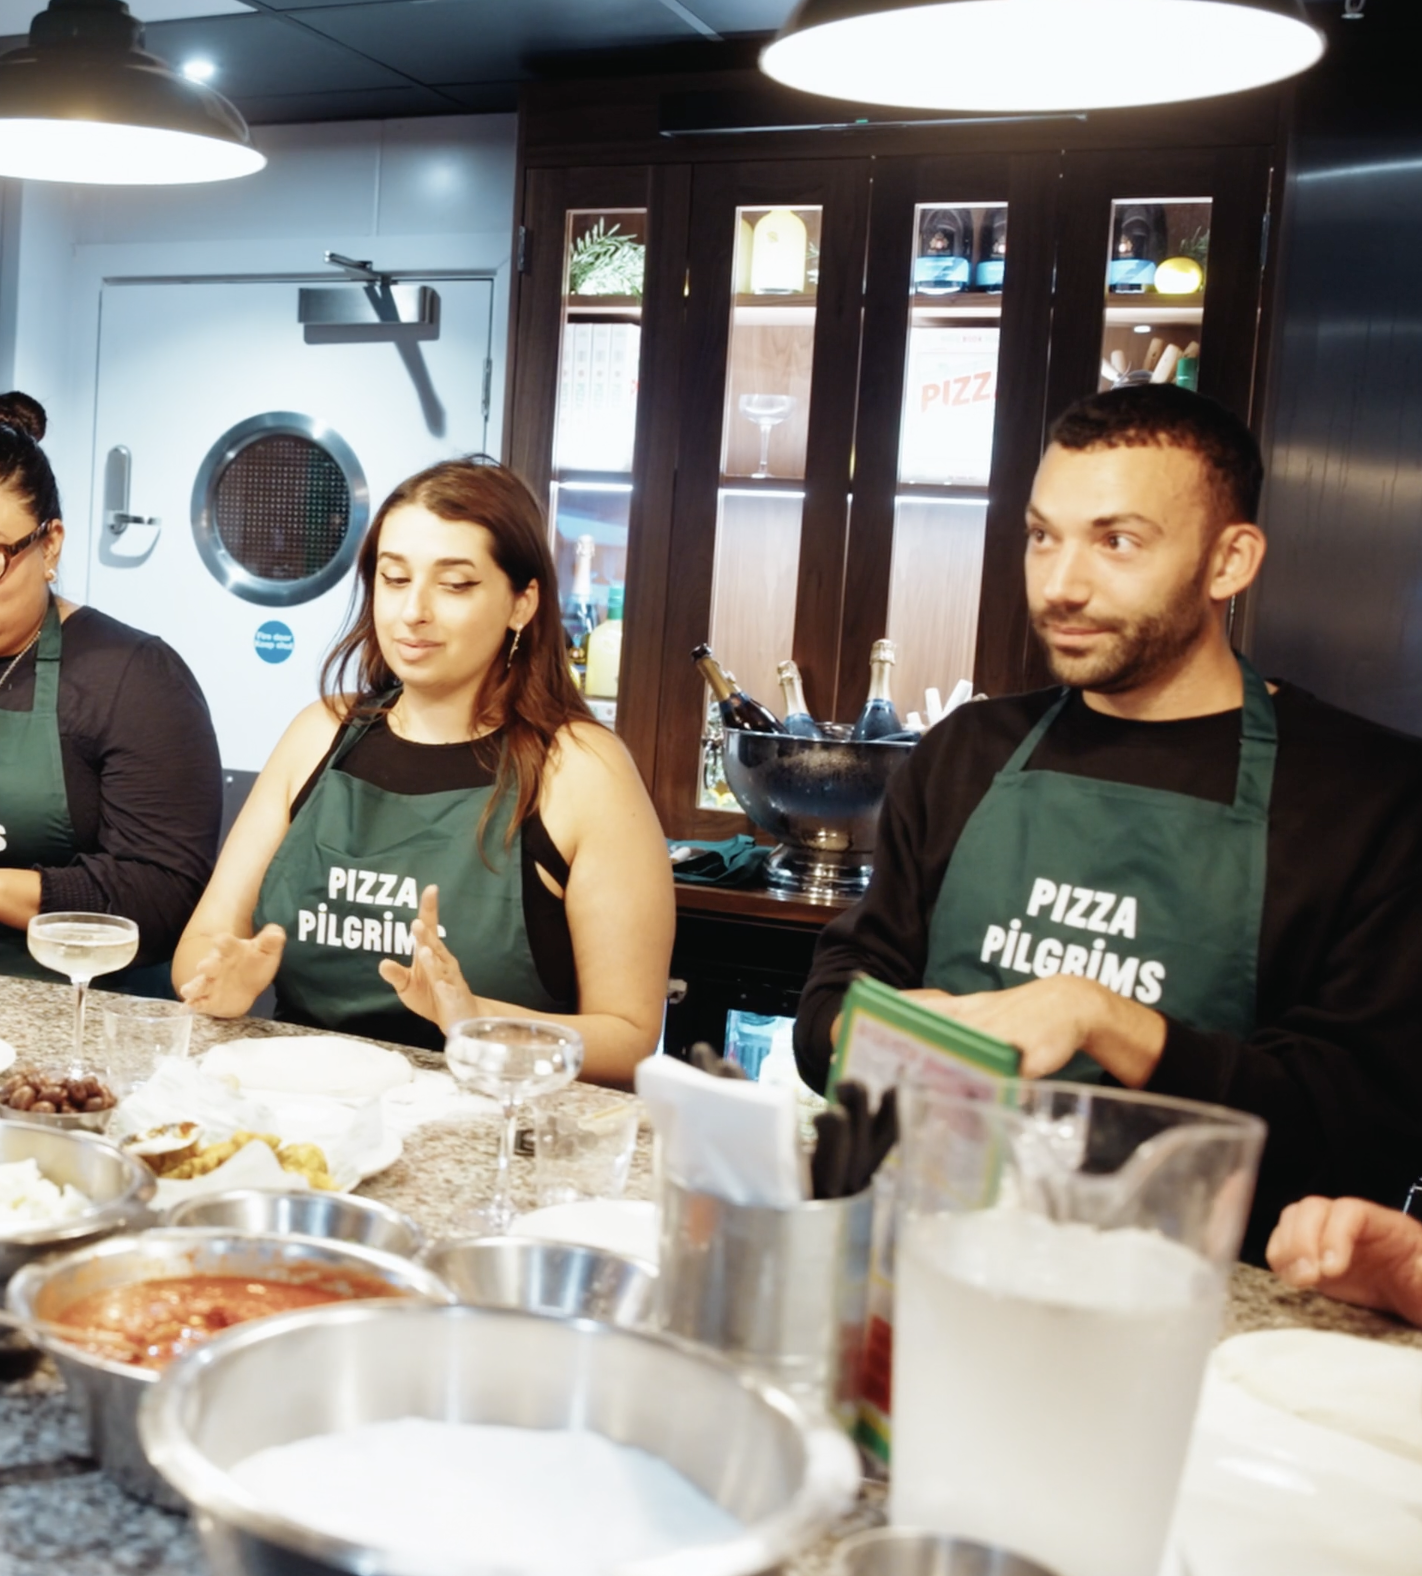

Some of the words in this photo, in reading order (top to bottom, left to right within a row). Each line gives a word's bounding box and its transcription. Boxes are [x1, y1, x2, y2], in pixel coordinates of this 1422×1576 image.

[920, 371, 997, 413] PIZZ
[328, 866, 418, 909] PIZZA
[1026, 877, 1138, 940] PIZZA
[298, 902, 446, 955] PiLGRiM
